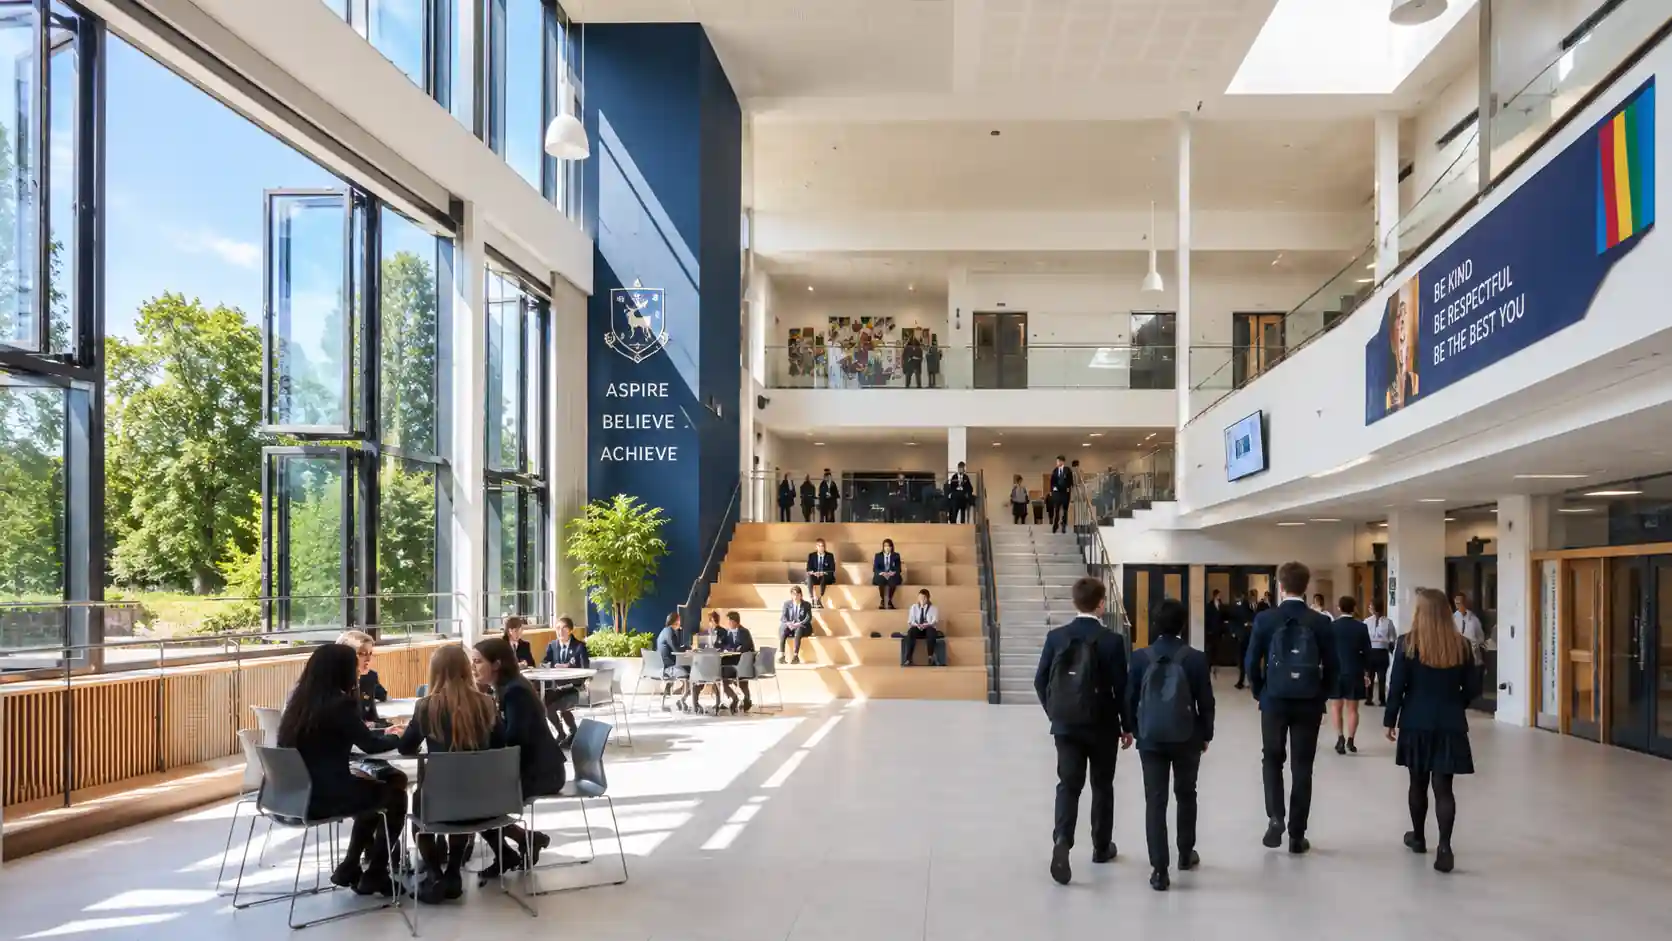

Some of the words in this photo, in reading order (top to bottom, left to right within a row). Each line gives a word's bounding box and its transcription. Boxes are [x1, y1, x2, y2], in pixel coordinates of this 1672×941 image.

[1434, 277, 1446, 303] BE
[1448, 259, 1473, 293] KIND
[1434, 309, 1446, 334] BE
[1447, 265, 1513, 326] RESPECTFUL
[1434, 341, 1446, 366] BE
[1447, 328, 1467, 356] THE
[1469, 310, 1497, 346] BEST
[1499, 293, 1525, 329] YOU
[605, 383, 669, 398] ASPIRE
[602, 414, 675, 429] BELIEVE
[600, 446, 678, 462] ACHIEVE
